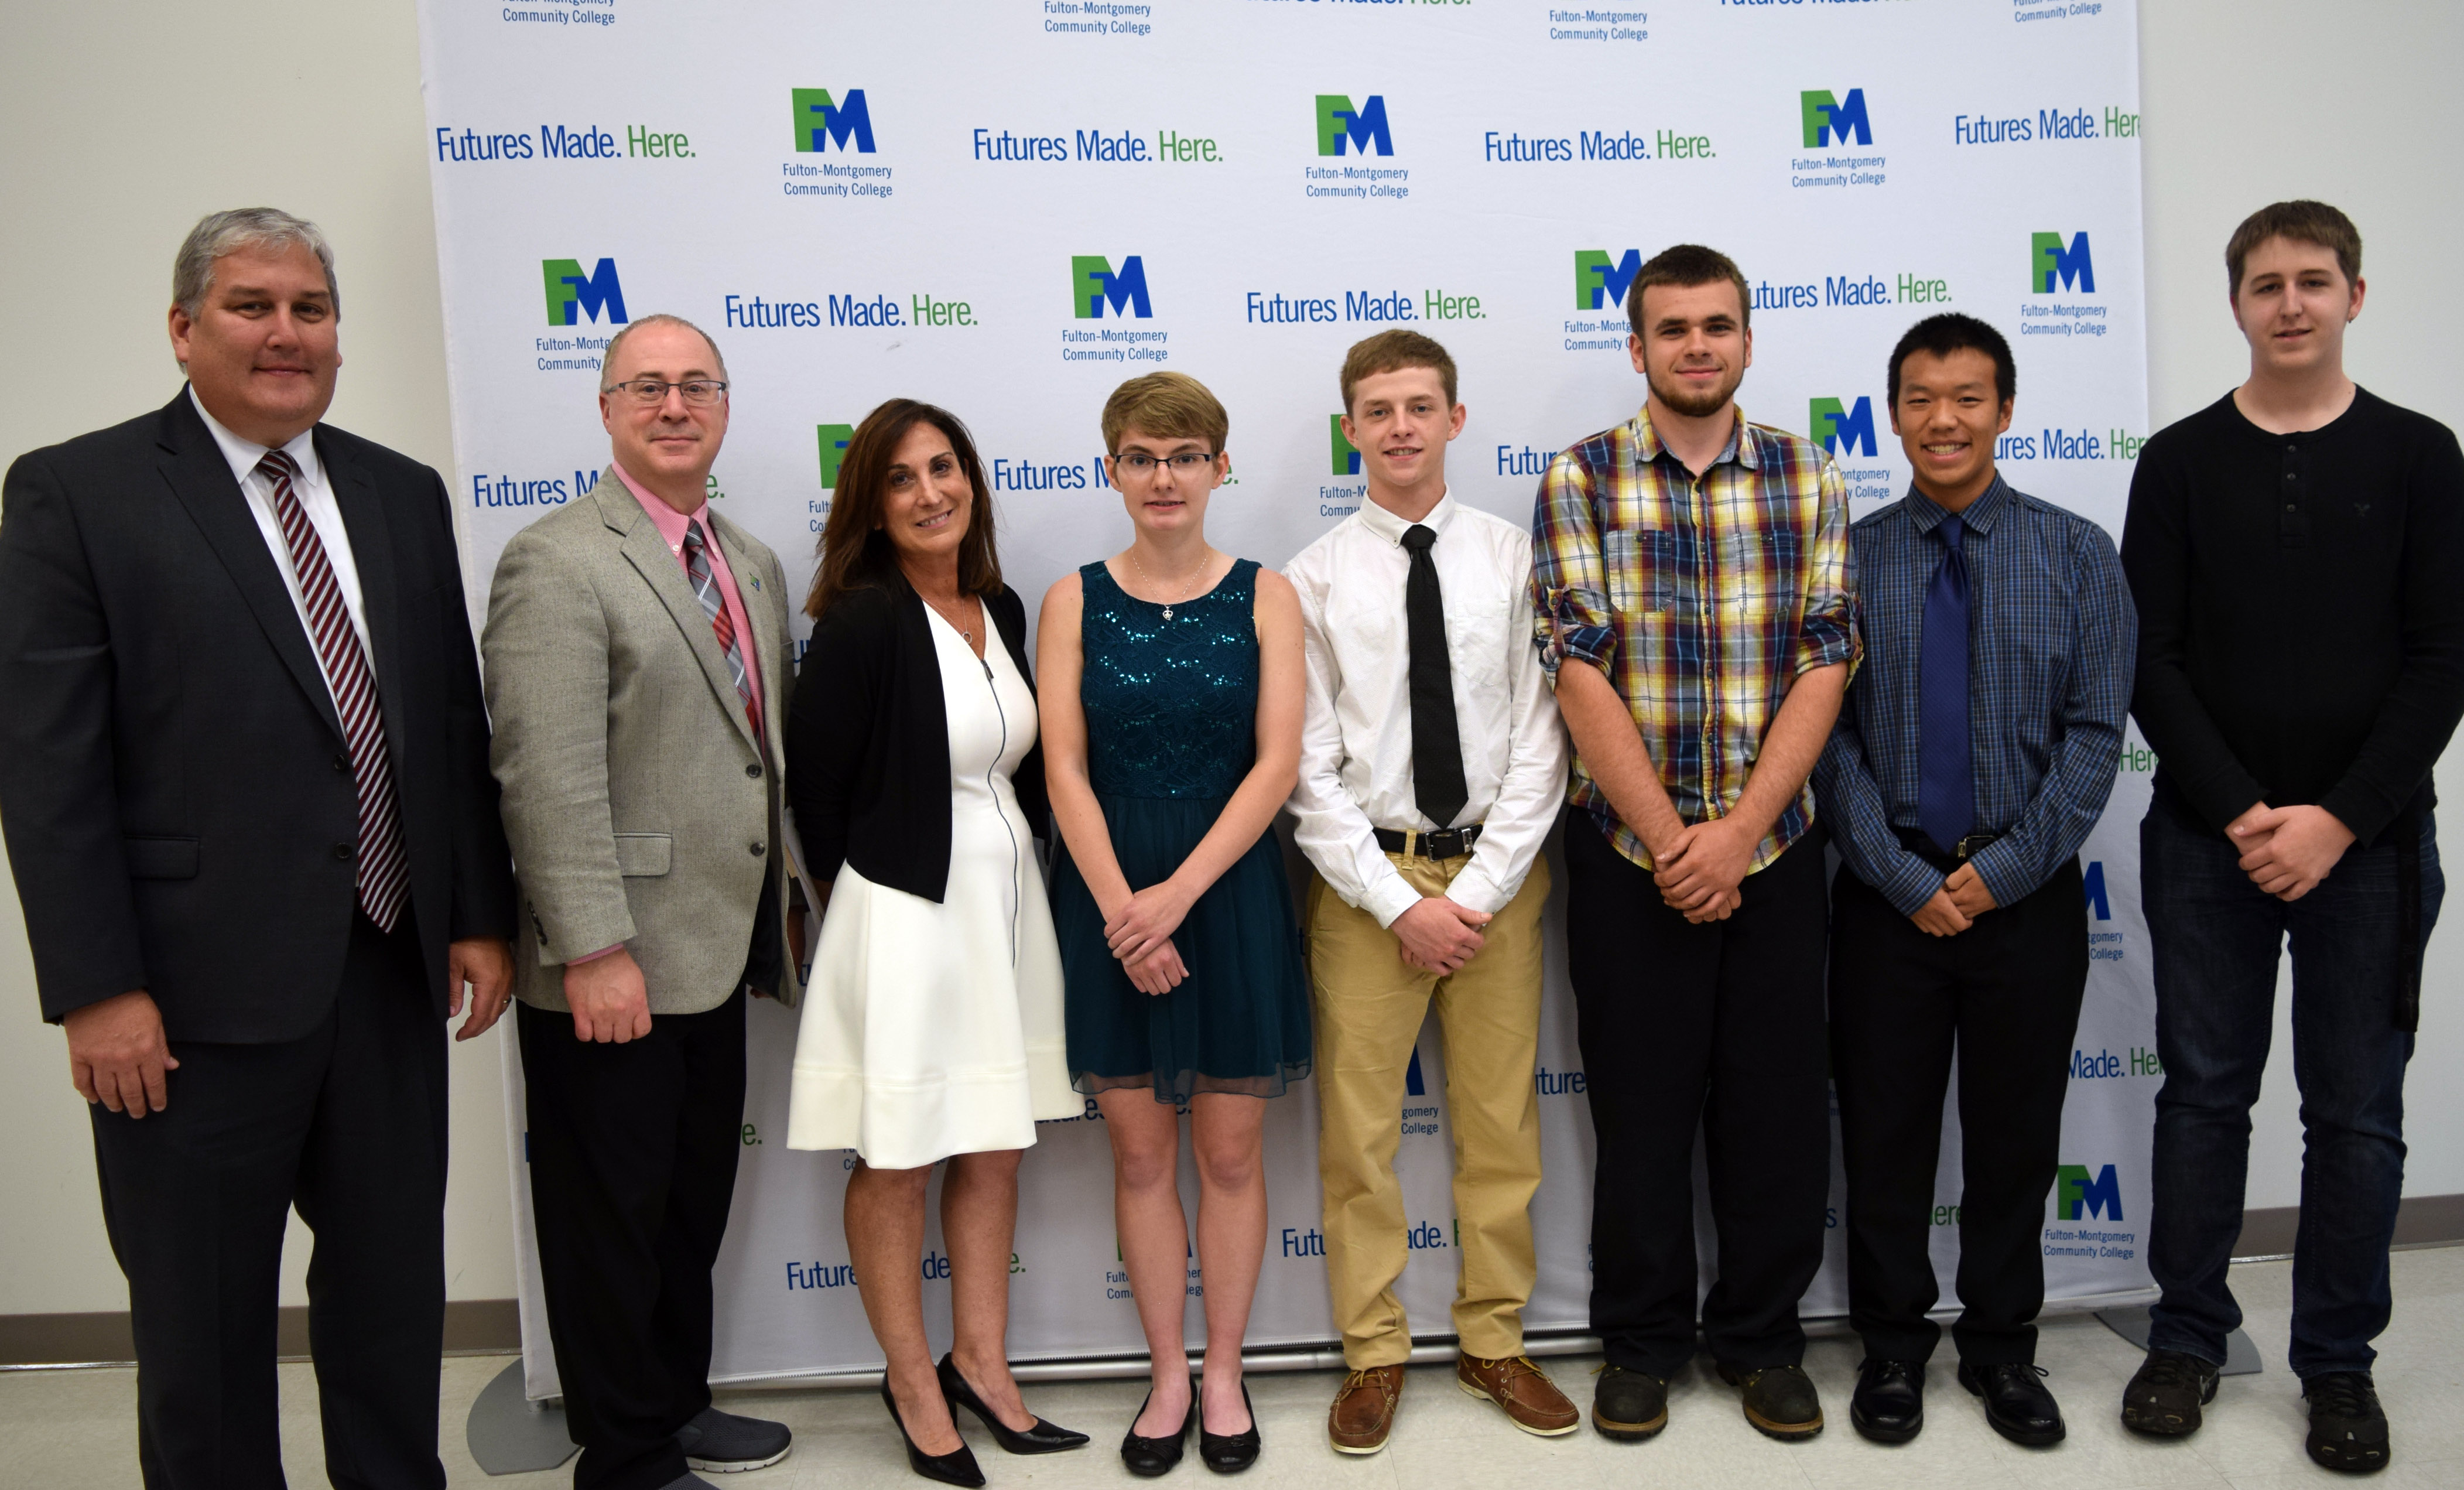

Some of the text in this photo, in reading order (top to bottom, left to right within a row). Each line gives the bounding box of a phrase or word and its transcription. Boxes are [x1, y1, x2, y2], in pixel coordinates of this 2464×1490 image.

[502, 8, 615, 26] Community College
[1044, 1, 1151, 18] Fulton-Montgomery
[1549, 9, 1648, 25] Fulton-Montgomery
[2014, 2, 2102, 22] Community College
[1045, 19, 1151, 36] Community College
[1550, 27, 1648, 42] Community College
[791, 88, 877, 153] FM
[1315, 94, 1394, 156] FM
[1801, 88, 1873, 149] FM
[1955, 105, 2140, 145] Futures Made. Her
[436, 125, 696, 162] Futures Made. Here.
[973, 128, 1223, 162] Futures Made. Here.
[1485, 129, 1716, 162] Futures Made. Here.
[783, 163, 892, 179] Fulton-Montgomery
[1792, 156, 1886, 170] Fulton-Montgomery
[1306, 166, 1408, 182] Fulton-Montgomery
[1792, 172, 1885, 188] Community College
[784, 182, 892, 198] Community College
[1306, 184, 1409, 199] Community College
[2031, 231, 2096, 294] FM
[542, 258, 628, 326] FM
[1072, 255, 1153, 319] FM
[1745, 273, 1952, 309] utures Made. Here.
[725, 293, 978, 328] Futures Made. Here.
[1247, 289, 1486, 323] Futures Made. Here.
[2021, 304, 2107, 319] Fulton-Montgomery
[1565, 320, 1632, 334] Fulton-Montg
[2021, 322, 2107, 337] Community College
[536, 336, 611, 351] Fulton-Montg
[1062, 329, 1168, 344] Fulton-Montgomery
[1565, 337, 1623, 351] Community
[538, 356, 601, 371] Community
[1063, 347, 1168, 363] Community College
[1993, 428, 2148, 460] ures Made. Her
[1497, 445, 1558, 476] Futur
[994, 459, 1086, 491] Futures
[1841, 469, 1891, 483] ontgomery
[473, 474, 568, 508] Futures
[1854, 485, 1890, 500] College
[2120, 741, 2158, 773] Her
[2089, 947, 2124, 962] College
[1401, 1122, 1439, 1136] College
[2056, 1164, 2124, 1221] FM
[2044, 1229, 2136, 1244] Fulton-Montgomery
[2043, 1245, 2134, 1260] Community College
[786, 1261, 858, 1290] Future
